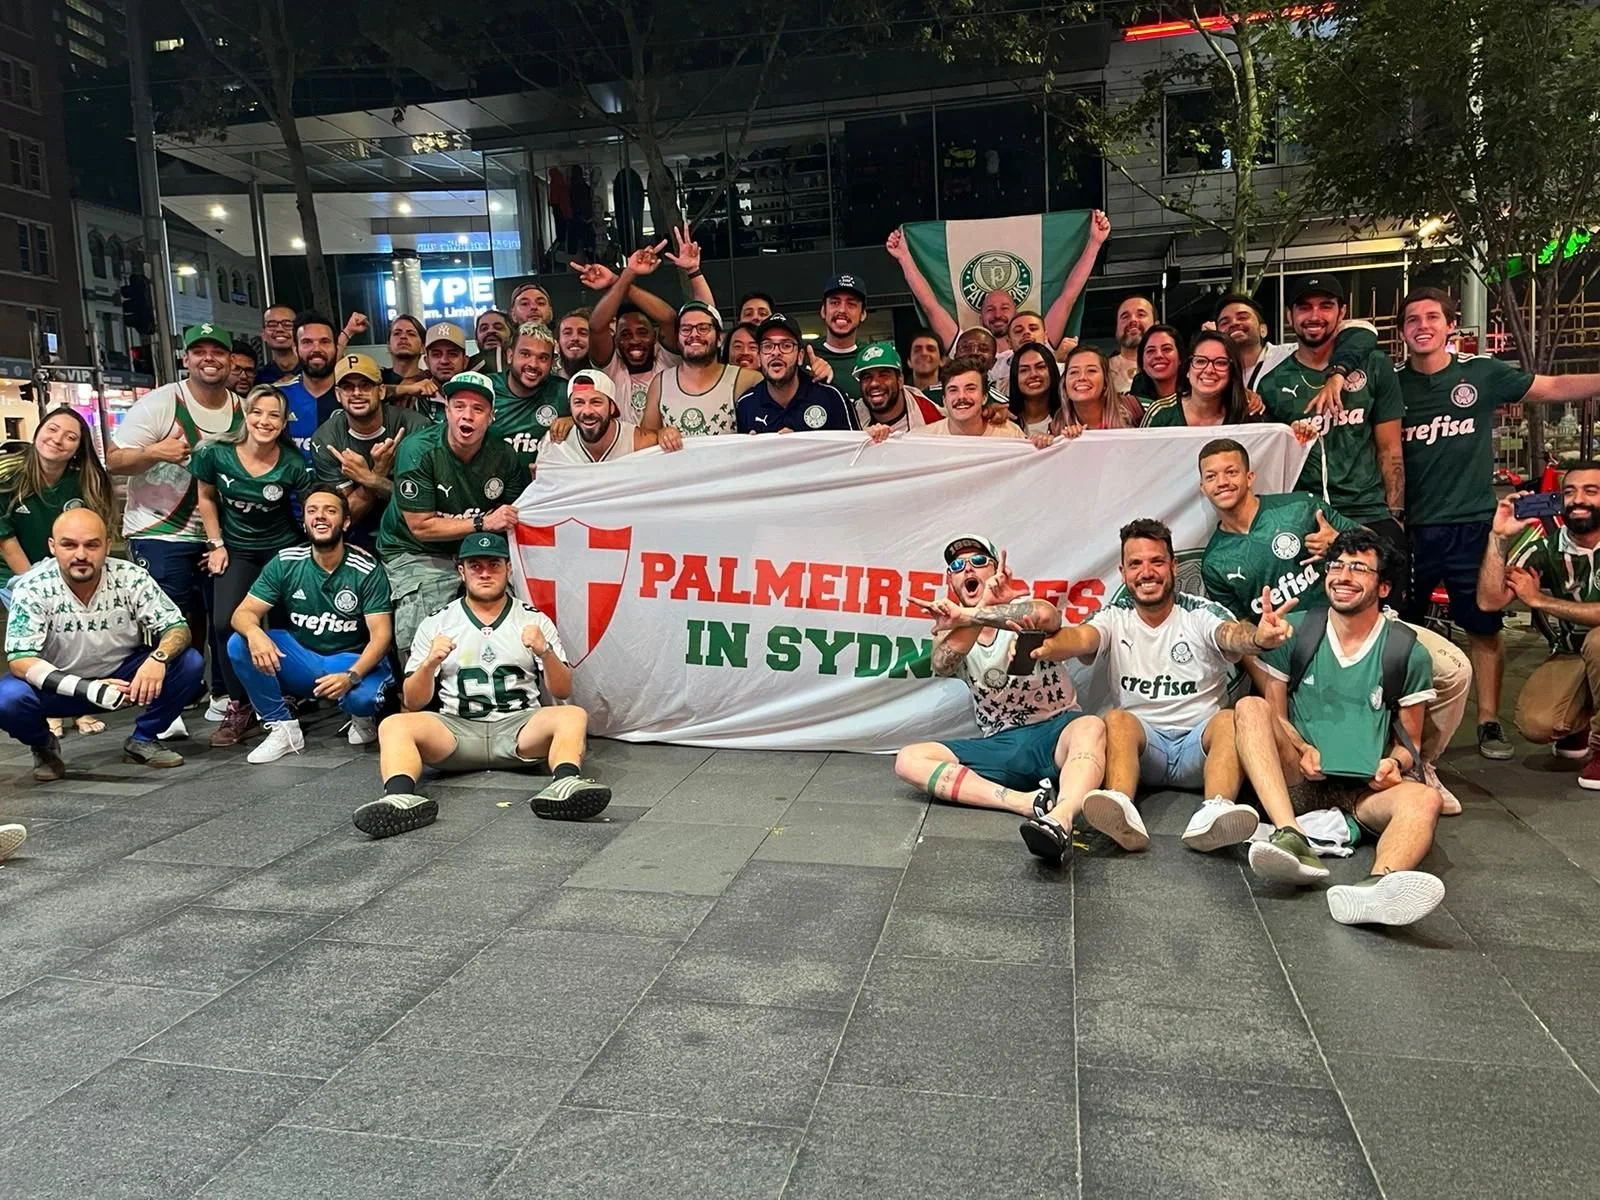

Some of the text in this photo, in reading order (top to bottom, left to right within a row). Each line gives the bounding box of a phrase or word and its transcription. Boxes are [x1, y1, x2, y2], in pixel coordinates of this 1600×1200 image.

[963, 281, 1029, 310] PALRAS
[66, 369, 91, 382] VIP
[347, 355, 359, 369] P
[1298, 407, 1365, 437] efisa
[1400, 414, 1476, 446] refisa
[1250, 563, 1320, 615] cefisa
[290, 611, 358, 636] crefisa
[685, 619, 934, 680] IN SYDN
[456, 665, 532, 720] 66
[1121, 675, 1198, 700] crefisa
